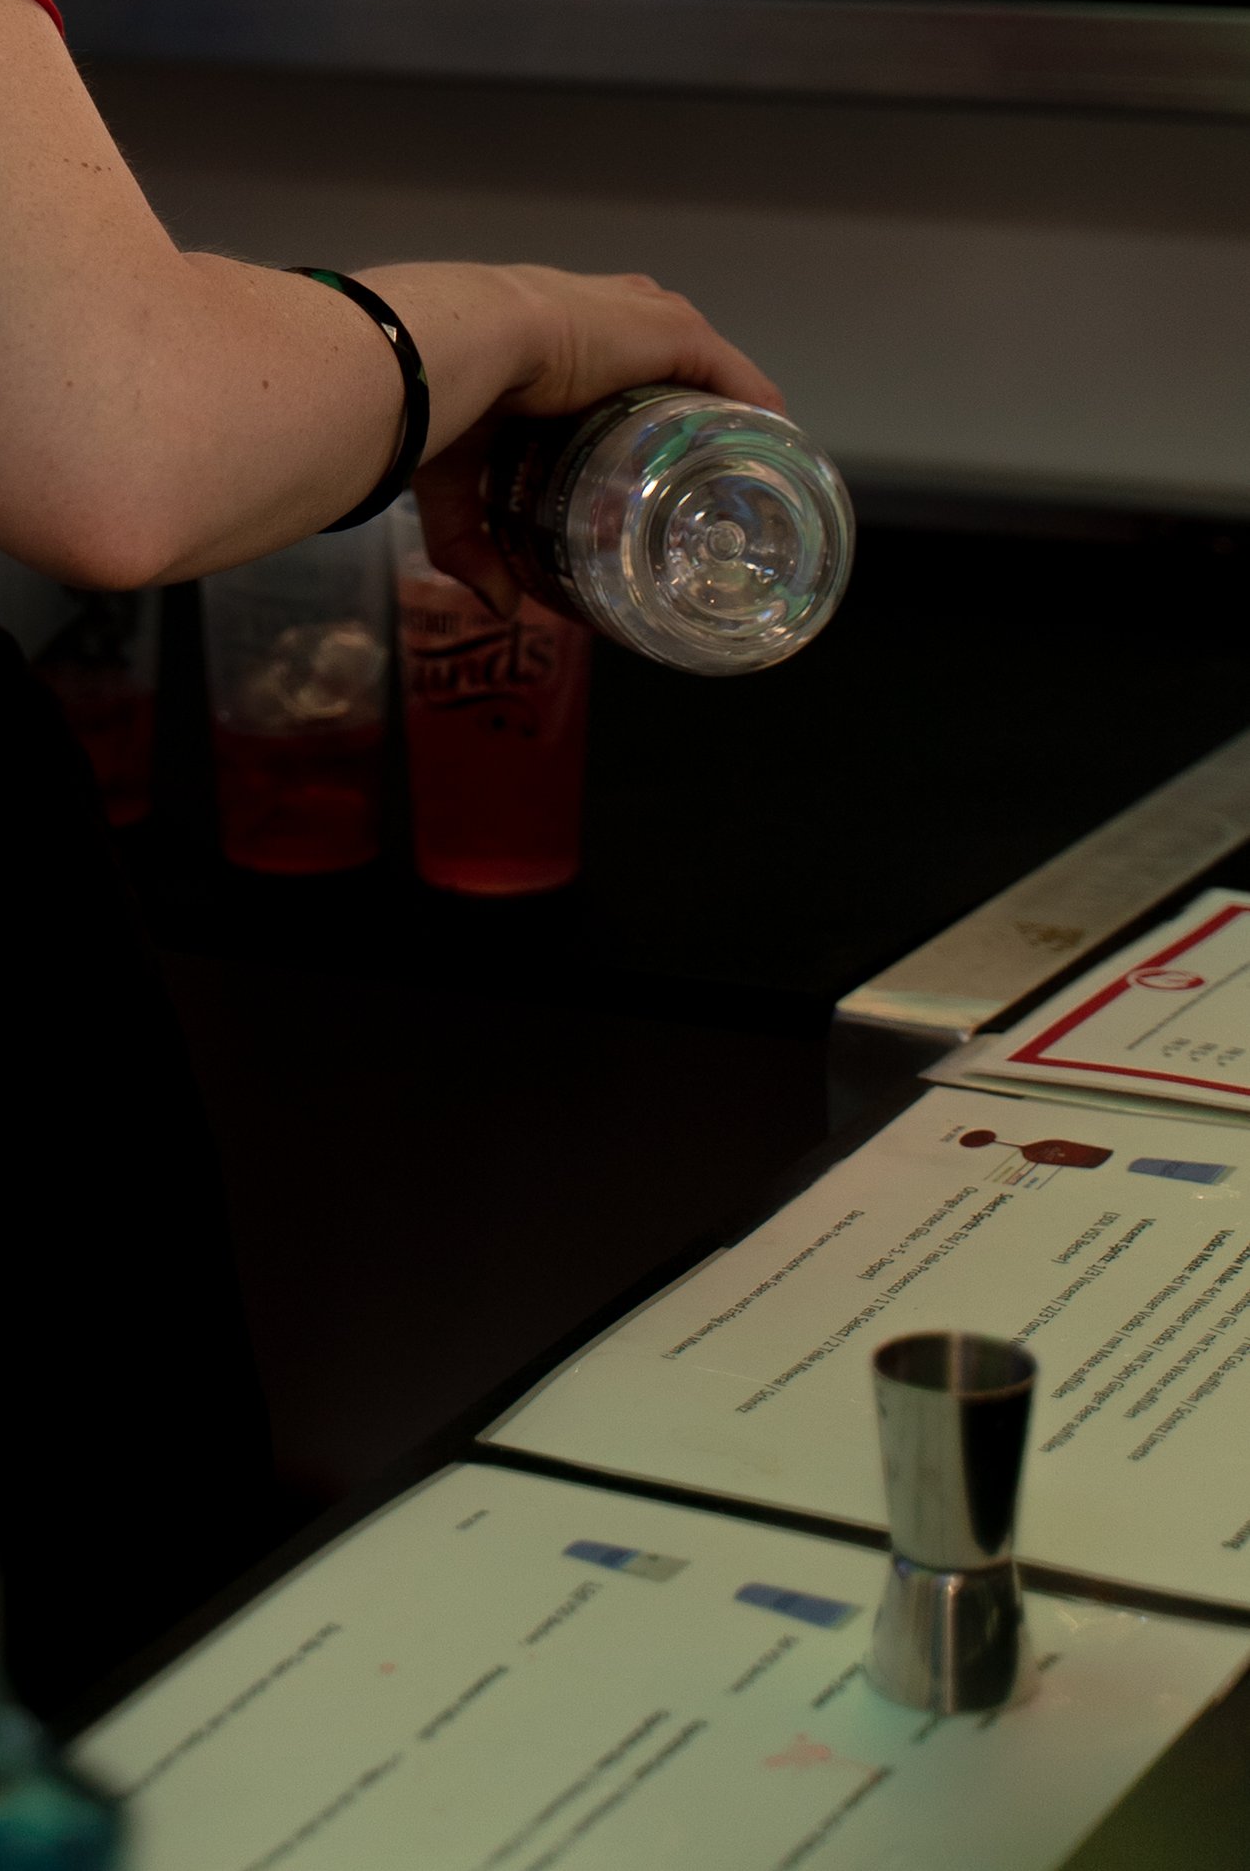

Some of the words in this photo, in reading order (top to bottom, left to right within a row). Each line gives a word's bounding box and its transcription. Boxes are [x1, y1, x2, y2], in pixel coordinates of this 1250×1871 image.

[942, 1186, 979, 1210] Orange
[981, 1192, 1015, 1214] Select
[843, 1209, 866, 1222] Das
[921, 1207, 954, 1229] (rotes
[958, 1211, 994, 1233] Spritz:
[811, 1219, 853, 1249] Bar-Team
[904, 1226, 932, 1242] Glas
[1080, 1227, 1105, 1241] VSS
[1118, 1217, 1158, 1245] Vincent
[1201, 1229, 1236, 1253] Vodka
[919, 1249, 950, 1266] Teile
[938, 1243, 955, 1251] 3
[1050, 1238, 1092, 1265] Becher)
[1096, 1242, 1131, 1265] Spritz:
[781, 1246, 818, 1273] wünscht
[855, 1257, 896, 1281] Depot)
[1083, 1263, 1107, 1278] 1/3
[1181, 1251, 1214, 1275] Mate:
[886, 1264, 931, 1295] Prosecco
[1212, 1264, 1244, 1288] Mule:
[748, 1280, 780, 1298] Spass
[879, 1292, 897, 1301] /
[1055, 1276, 1096, 1302] Vincent
[1143, 1284, 1183, 1312] Weisser
[734, 1295, 756, 1310] und
[859, 1304, 886, 1319] Teil
[1038, 1304, 1063, 1320] 2/3
[1050, 1298, 1068, 1308] /
[1175, 1297, 1214, 1325] Weisser
[834, 1315, 870, 1338] Select
[1017, 1318, 1051, 1338] Tonic
[1120, 1310, 1155, 1333] Vodka
[1208, 1327, 1226, 1336] /
[1214, 1315, 1238, 1330] Gin
[822, 1340, 841, 1349] 2
[828, 1335, 846, 1344] /
[1101, 1335, 1124, 1350] mit
[1114, 1330, 1132, 1339] /
[1151, 1324, 1186, 1347] Vodka
[1196, 1332, 1218, 1347] mit
[802, 1344, 835, 1364] Teile
[1082, 1348, 1114, 1369] Mate
[1132, 1349, 1155, 1364] mit
[1145, 1343, 1164, 1353] /
[1177, 1346, 1210, 1366] Tonic
[1112, 1361, 1146, 1383] Spicy
[1216, 1354, 1245, 1372] Cola
[771, 1361, 814, 1388] Mineral
[1050, 1366, 1091, 1400] auffüllen
[1155, 1365, 1190, 1389] Water
[1090, 1380, 1126, 1407] Ginger
[1186, 1370, 1226, 1404] auffüllen
[734, 1388, 777, 1414] Schnitz
[1122, 1386, 1164, 1420] auffüllen
[1180, 1400, 1198, 1410] /
[1072, 1404, 1102, 1424] Beer
[1154, 1406, 1193, 1435] Schnitz
[1039, 1421, 1081, 1454] auffüllen
[1126, 1432, 1167, 1463] Limette
